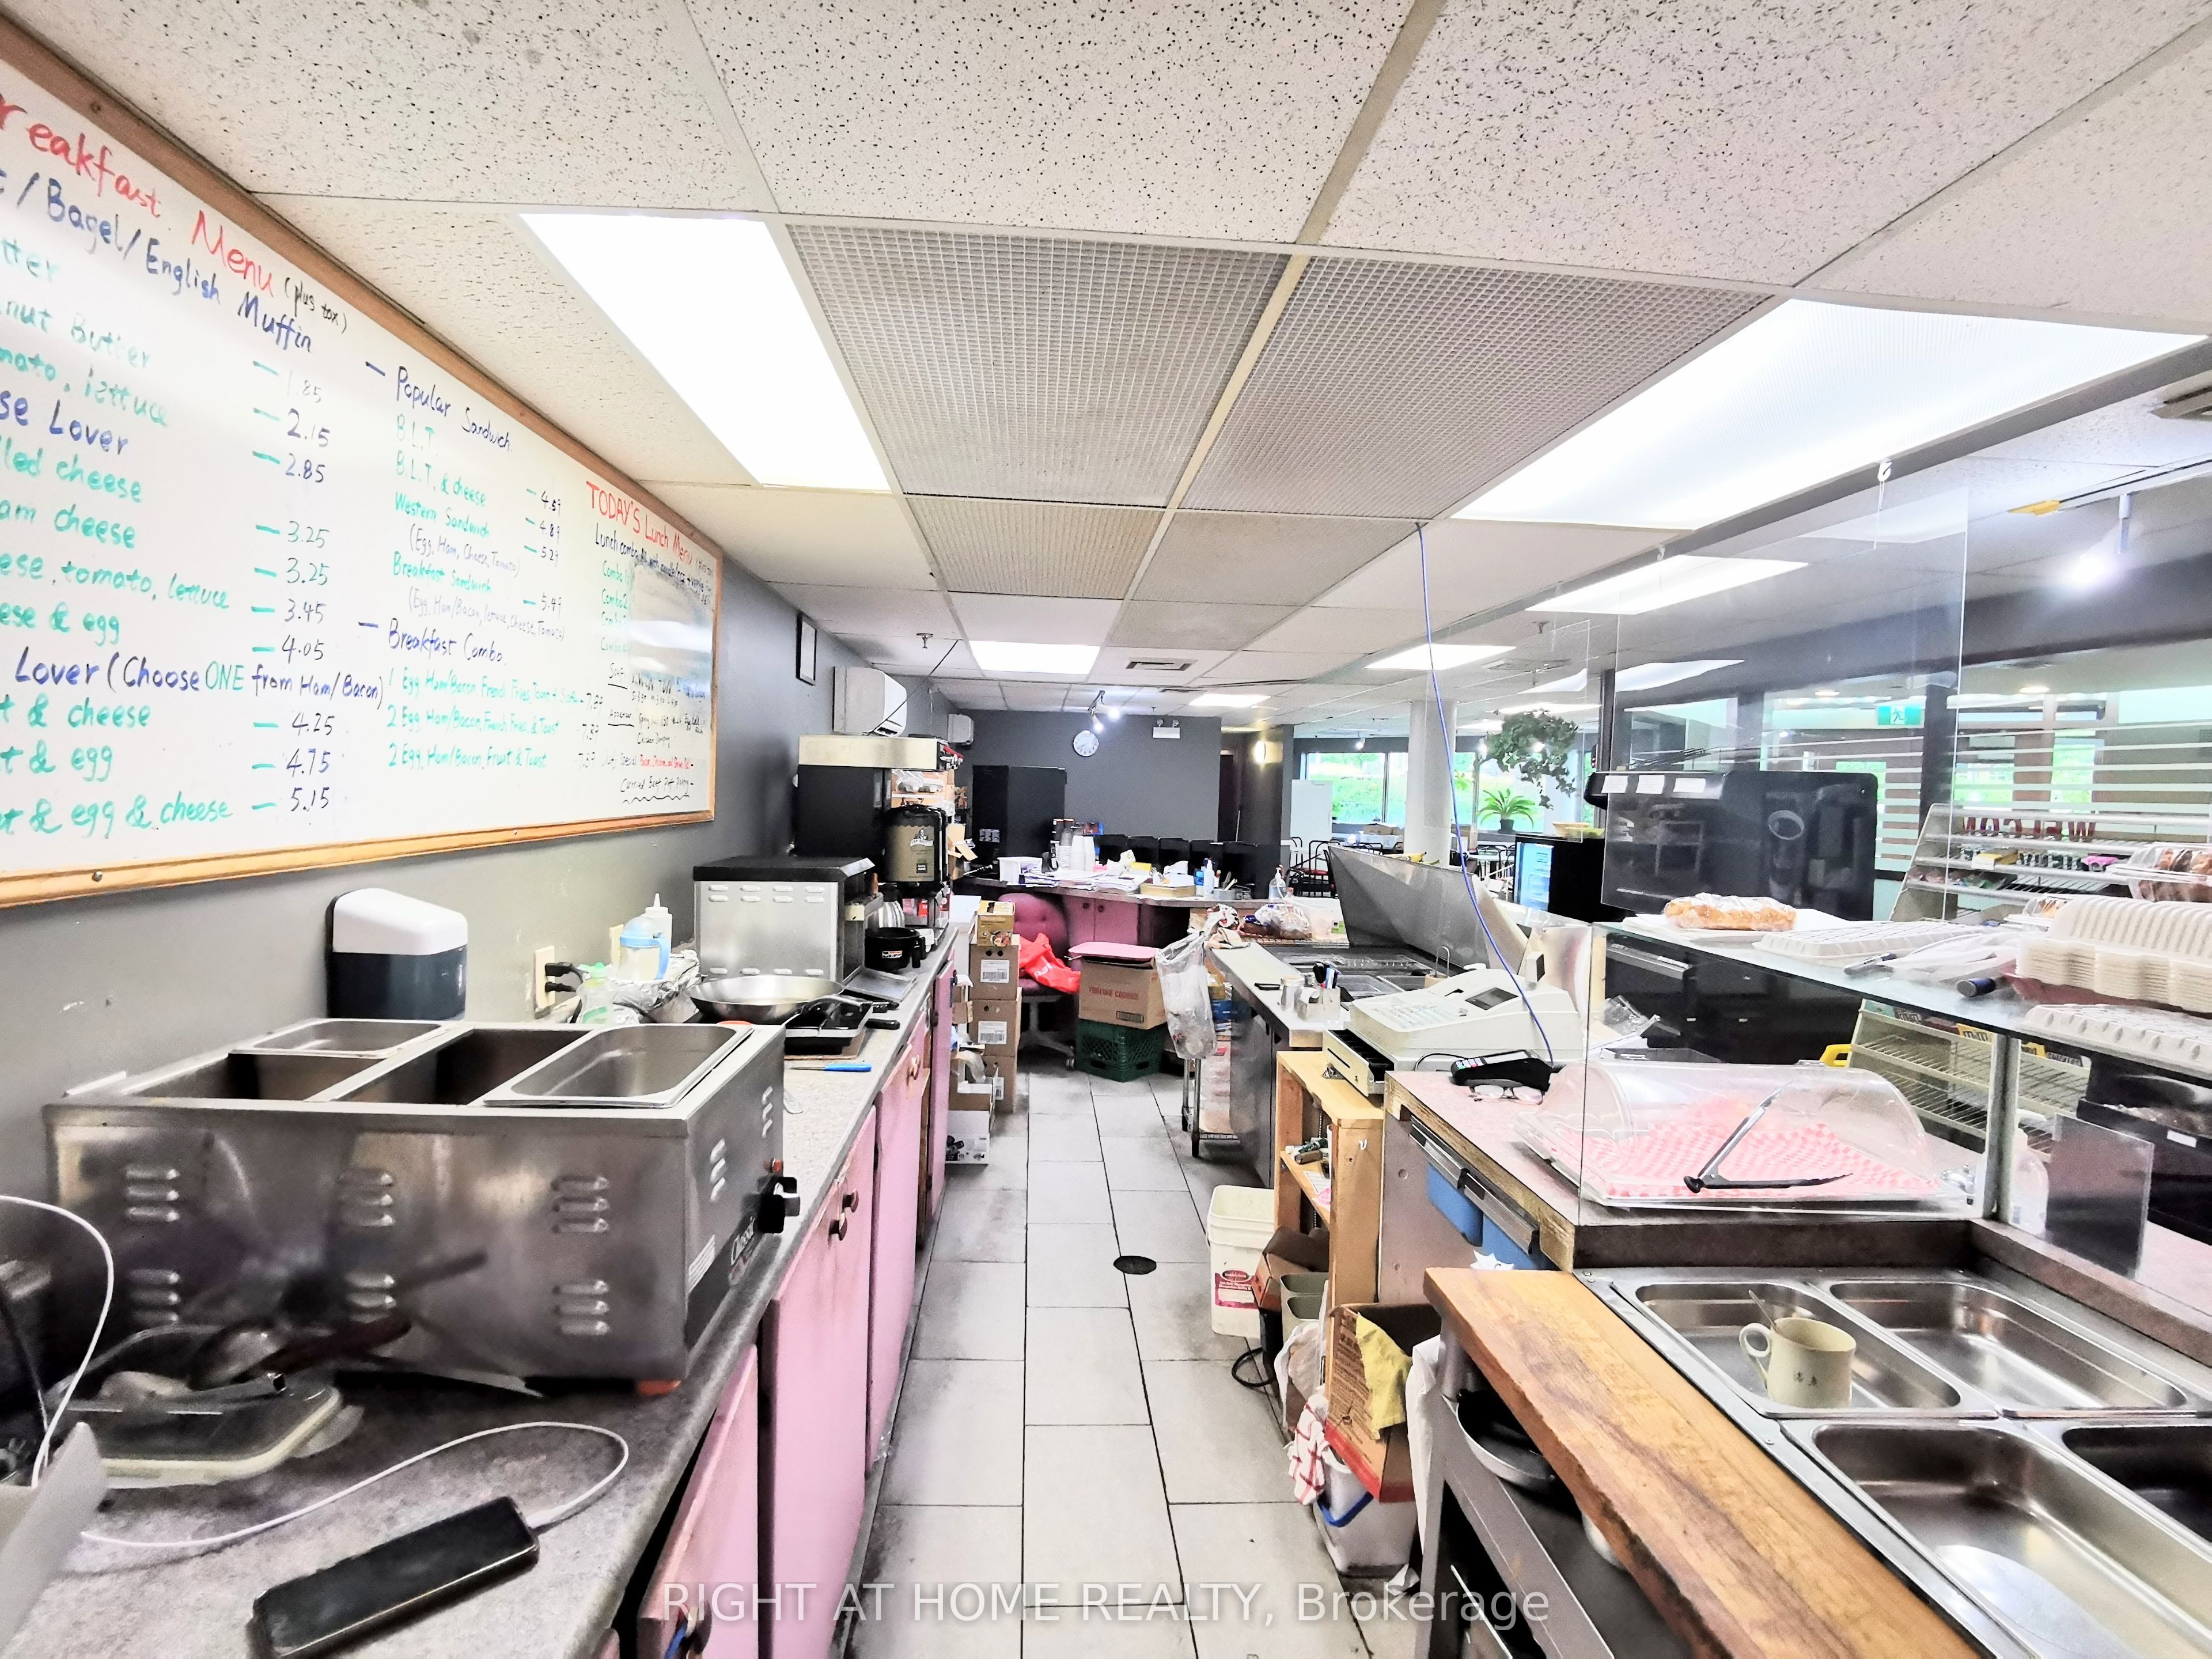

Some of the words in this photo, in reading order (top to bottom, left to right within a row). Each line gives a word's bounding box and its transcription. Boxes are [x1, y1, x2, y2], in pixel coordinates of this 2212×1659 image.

[192, 210, 274, 297] Menu
[71, 312, 151, 368] Butter
[238, 291, 312, 353] Muffin
[396, 365, 451, 416] Popular
[50, 399, 128, 454] Lover
[287, 408, 331, 448] 2.15
[56, 454, 142, 503] cheese
[285, 452, 325, 483] 2.85
[395, 491, 437, 521] Western
[586, 480, 640, 533] TODAY'S
[645, 513, 669, 548] Lunch
[55, 503, 135, 548] cheese
[287, 520, 329, 548] 3.25
[596, 522, 618, 554] Lunch
[286, 558, 330, 585] 3.25
[82, 612, 120, 646] egg
[285, 599, 327, 624] 3.45
[282, 634, 324, 664] 4.05
[389, 618, 457, 659] Breakfast
[15, 646, 100, 685] Lover
[107, 652, 200, 693] (Choose
[205, 661, 245, 691] ONE
[252, 664, 292, 696] from
[28, 692, 50, 727] &
[68, 697, 151, 728] cheese
[291, 711, 335, 737] 4.25
[387, 704, 396, 728] 2
[29, 739, 56, 774] &
[71, 745, 113, 782] egg
[389, 743, 397, 767] 2
[29, 798, 62, 834] &
[71, 801, 115, 839] egg
[160, 791, 234, 824] cheese
[290, 786, 329, 812] 5.15
